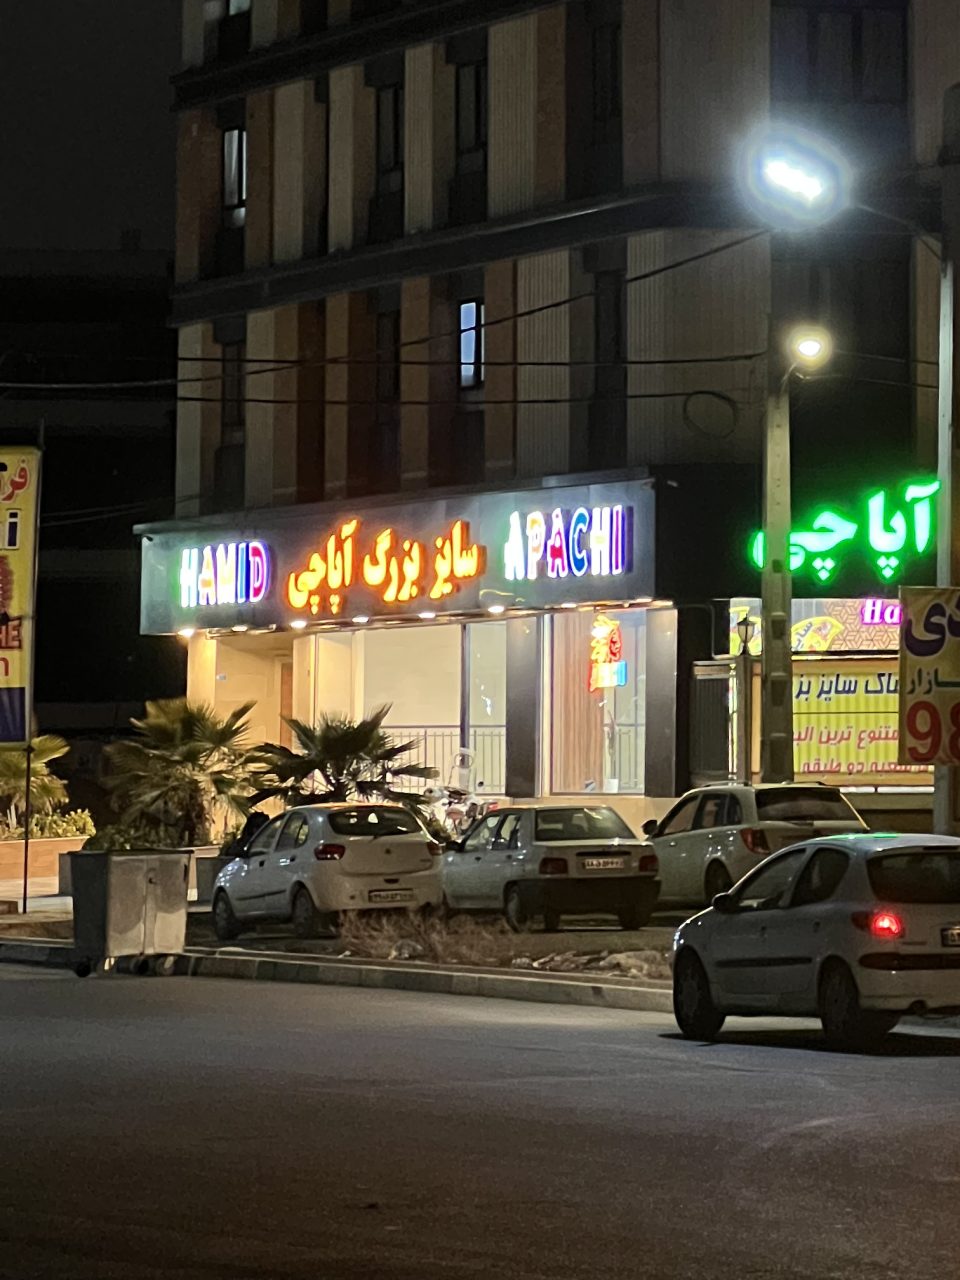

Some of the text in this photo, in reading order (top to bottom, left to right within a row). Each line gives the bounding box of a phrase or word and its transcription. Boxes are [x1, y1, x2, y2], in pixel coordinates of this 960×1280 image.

[179, 541, 268, 608] HAMID
[287, 519, 479, 615] سایز بزرگ آپاچی
[504, 504, 624, 581] APACHI
[816, 672, 858, 702] سایز
